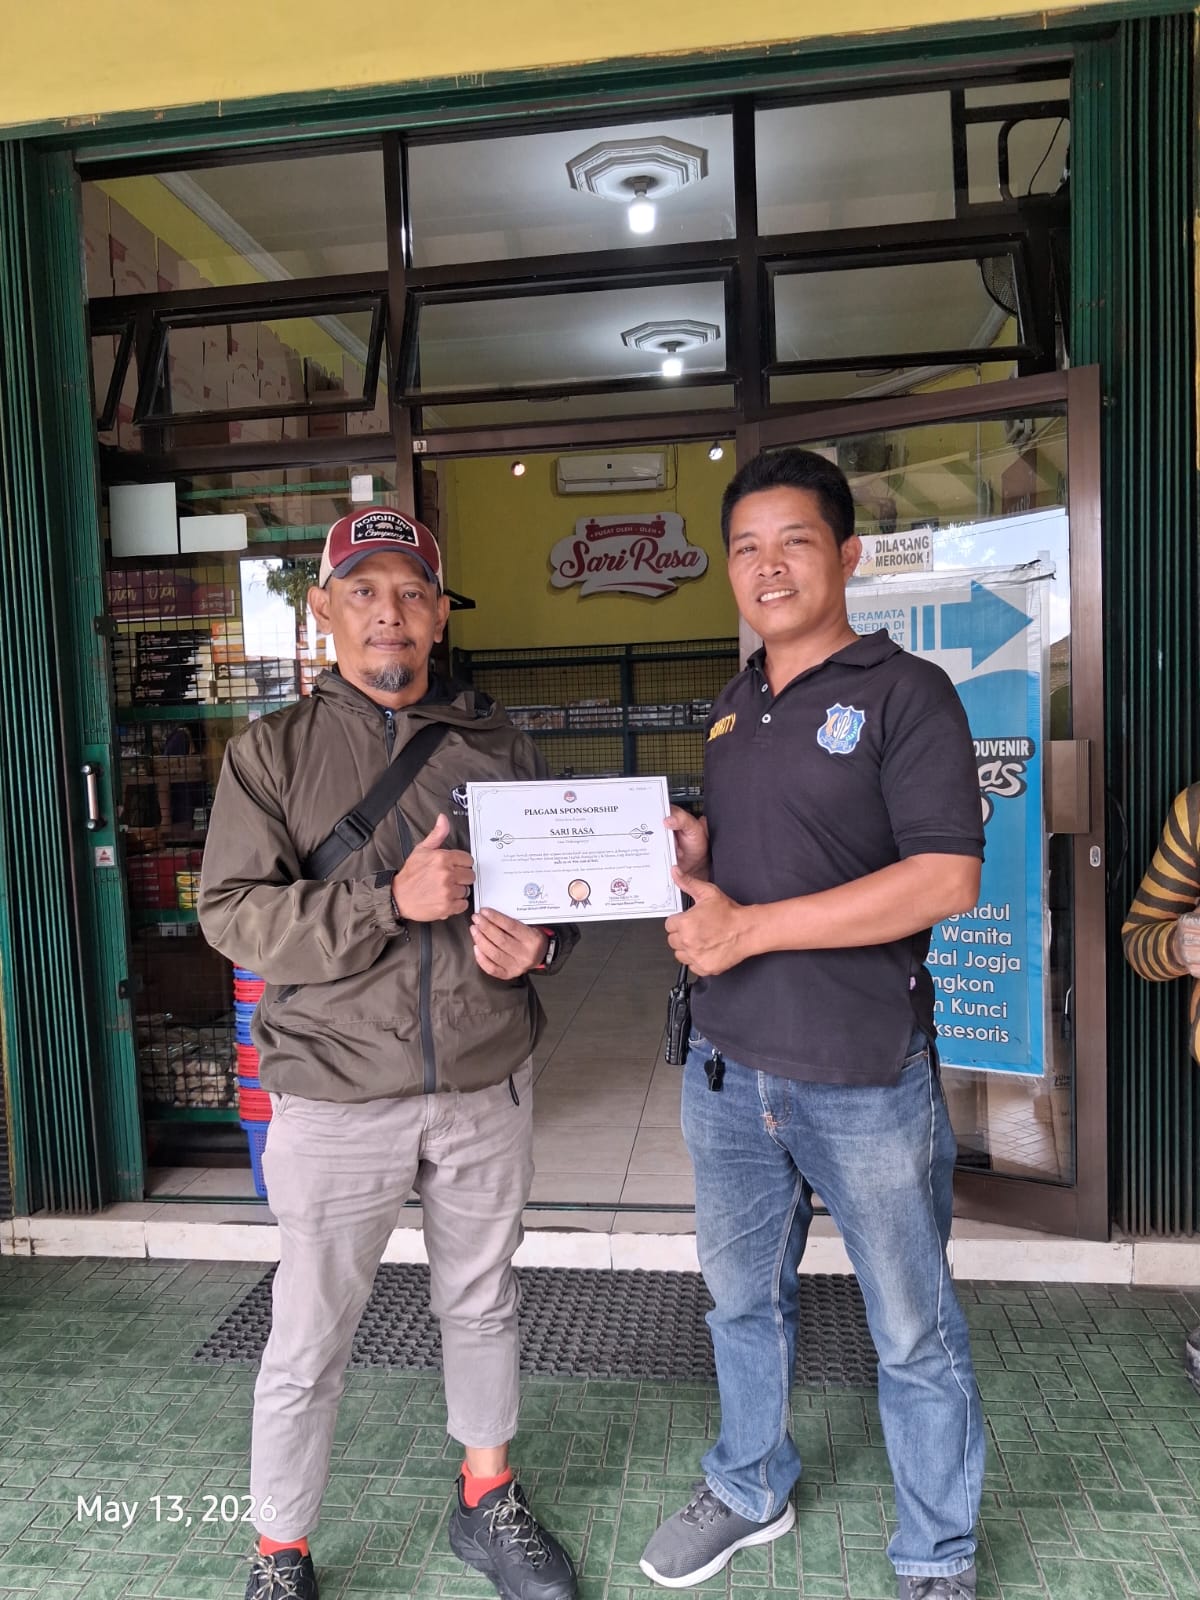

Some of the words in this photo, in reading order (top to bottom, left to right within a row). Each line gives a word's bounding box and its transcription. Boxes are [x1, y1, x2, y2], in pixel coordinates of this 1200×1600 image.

[364, 528, 405, 540] Company
[559, 540, 629, 579] Sari
[629, 537, 701, 574] Rasa
[875, 553, 923, 568] MEROKOK
[848, 609, 905, 622] ERAMATA
[893, 620, 905, 630] DI
[974, 739, 1030, 758] OUVENIR
[978, 760, 1023, 797] as
[524, 808, 558, 816] PIAGAM
[559, 805, 619, 815] SPONSORSHIP
[550, 828, 570, 836] SARI
[572, 827, 595, 835] RASA
[941, 925, 1012, 945] Wanita
[926, 949, 957, 966] dal
[964, 951, 1021, 974] Jogja
[932, 974, 994, 993] ngkon
[951, 998, 1007, 1018] Kunci
[933, 1020, 1009, 1043] ksesoris
